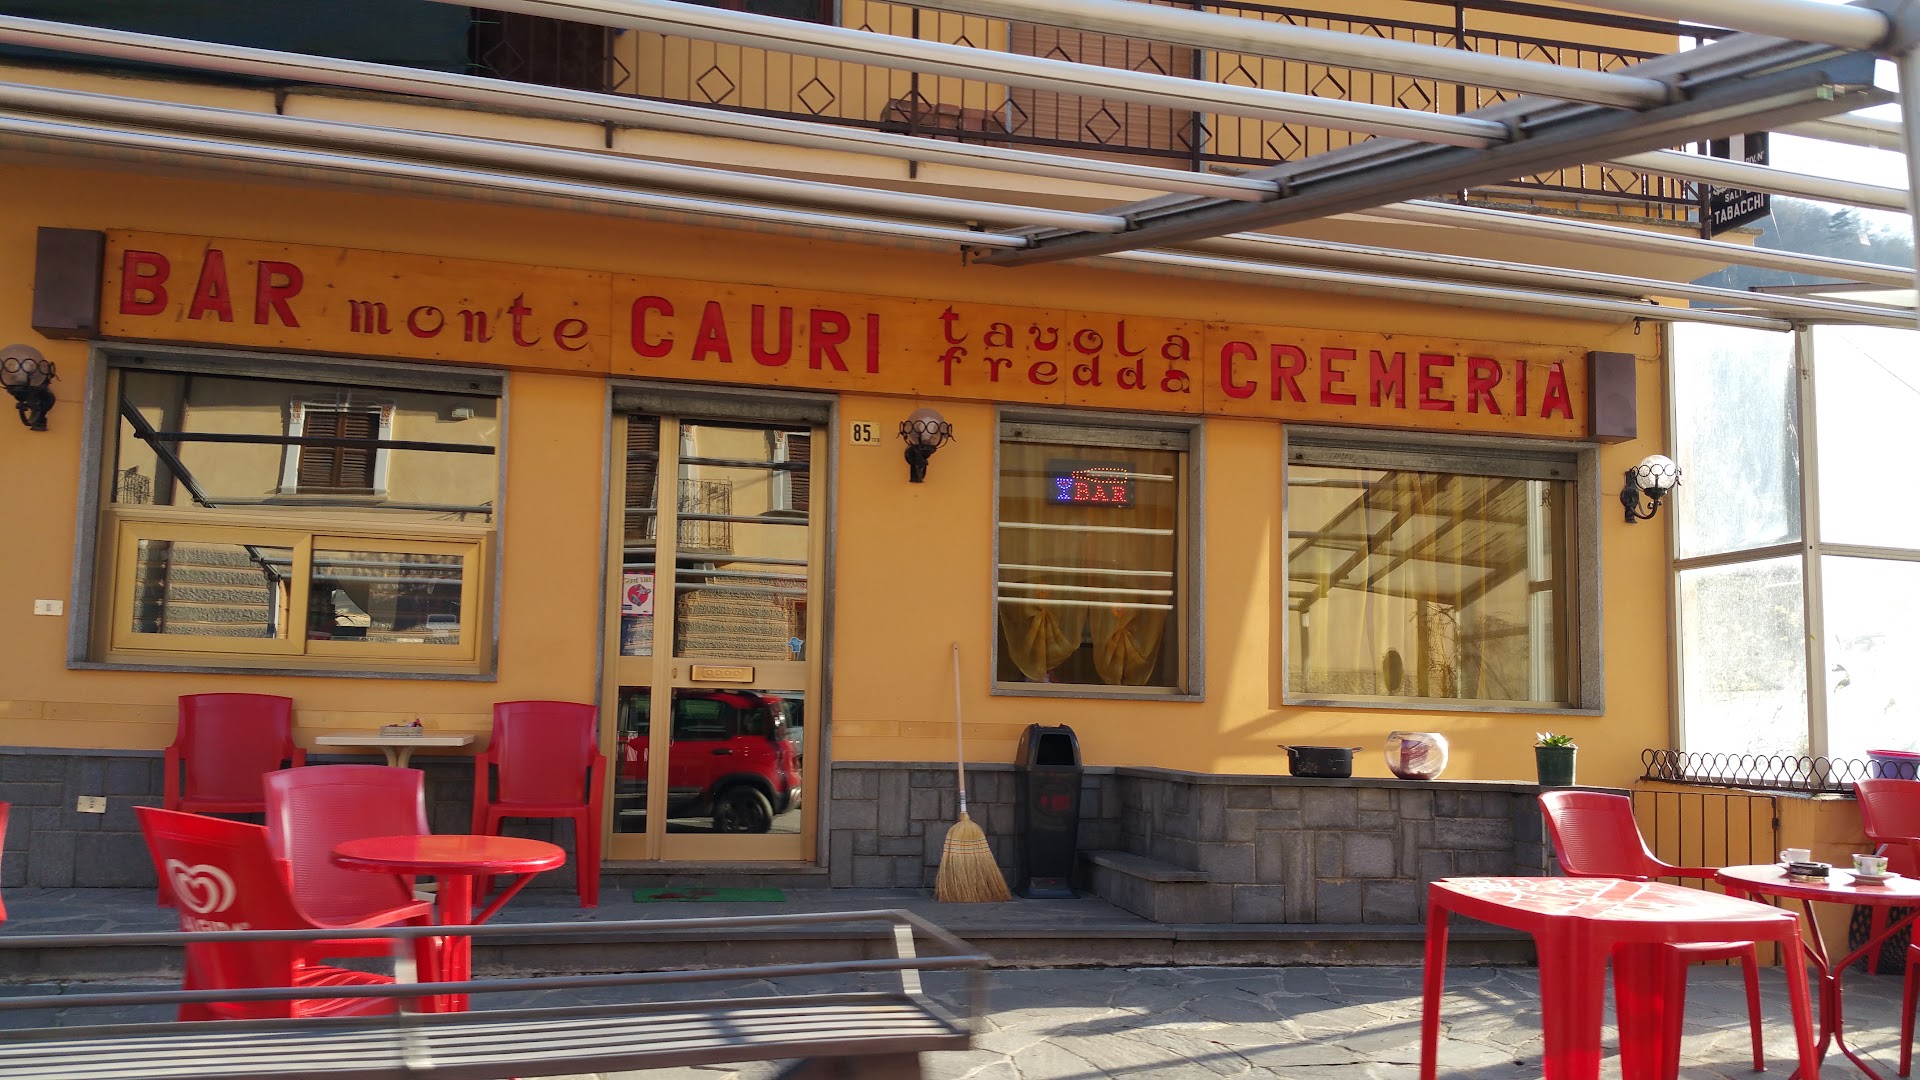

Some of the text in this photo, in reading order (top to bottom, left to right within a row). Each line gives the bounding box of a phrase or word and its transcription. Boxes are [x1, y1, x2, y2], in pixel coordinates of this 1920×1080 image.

[1714, 193, 1764, 225] TABACCHI
[119, 248, 880, 374] BAR monte CAURI
[938, 304, 1191, 363] tavola
[937, 346, 1191, 394] fredda
[1219, 340, 1575, 420] CREMERIA
[853, 424, 871, 442] 85
[1074, 482, 1127, 502] BAR
